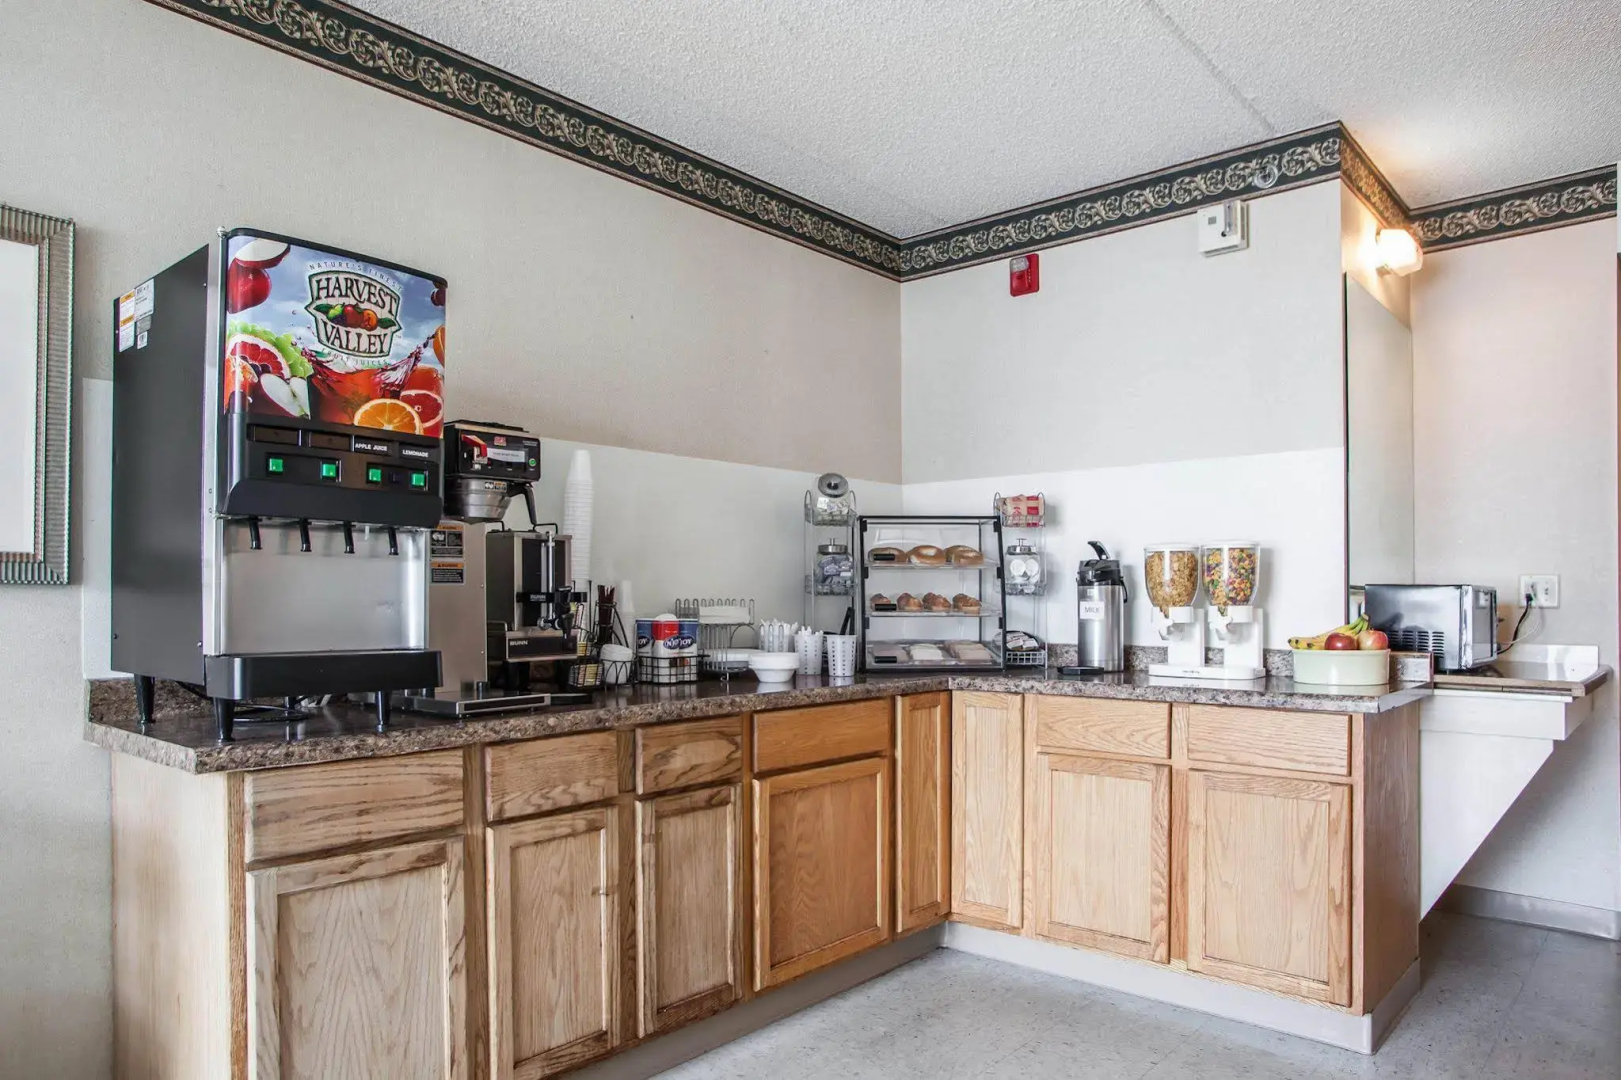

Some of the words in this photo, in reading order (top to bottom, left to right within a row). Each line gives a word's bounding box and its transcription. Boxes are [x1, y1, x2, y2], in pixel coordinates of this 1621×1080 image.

[309, 261, 362, 271] NATURE'S
[368, 268, 402, 291] FINEST
[315, 276, 397, 317] HARVEST
[320, 318, 388, 354] VALLEY
[402, 449, 429, 458] LEMONADE
[1084, 606, 1100, 614] MILK
